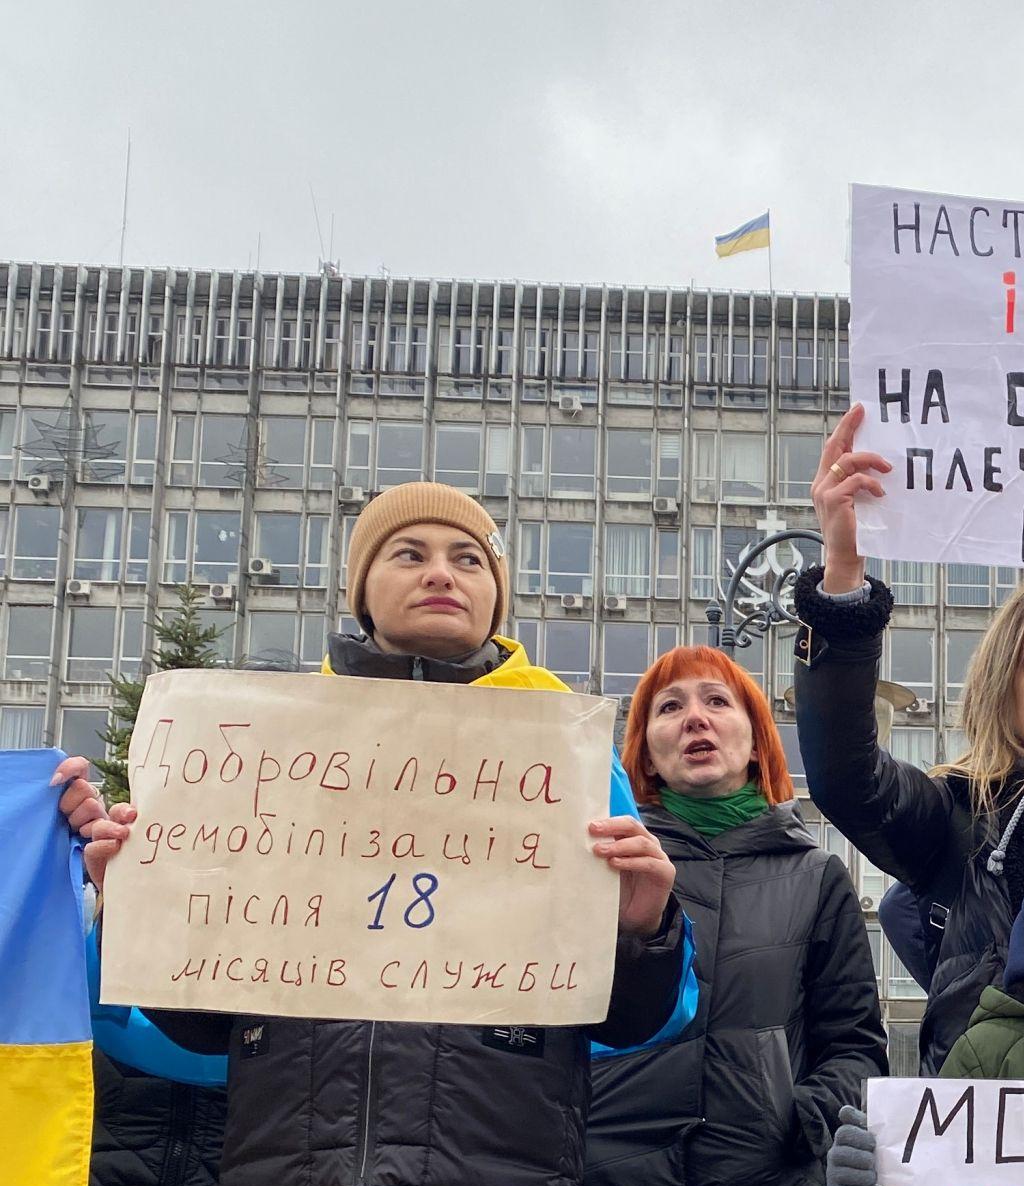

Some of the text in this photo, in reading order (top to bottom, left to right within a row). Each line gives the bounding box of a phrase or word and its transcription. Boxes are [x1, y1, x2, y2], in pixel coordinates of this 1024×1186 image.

[878, 368, 950, 425] НА
[132, 718, 562, 817] Добровільна
[187, 872, 439, 930] після 18
[171, 953, 347, 987] місяців
